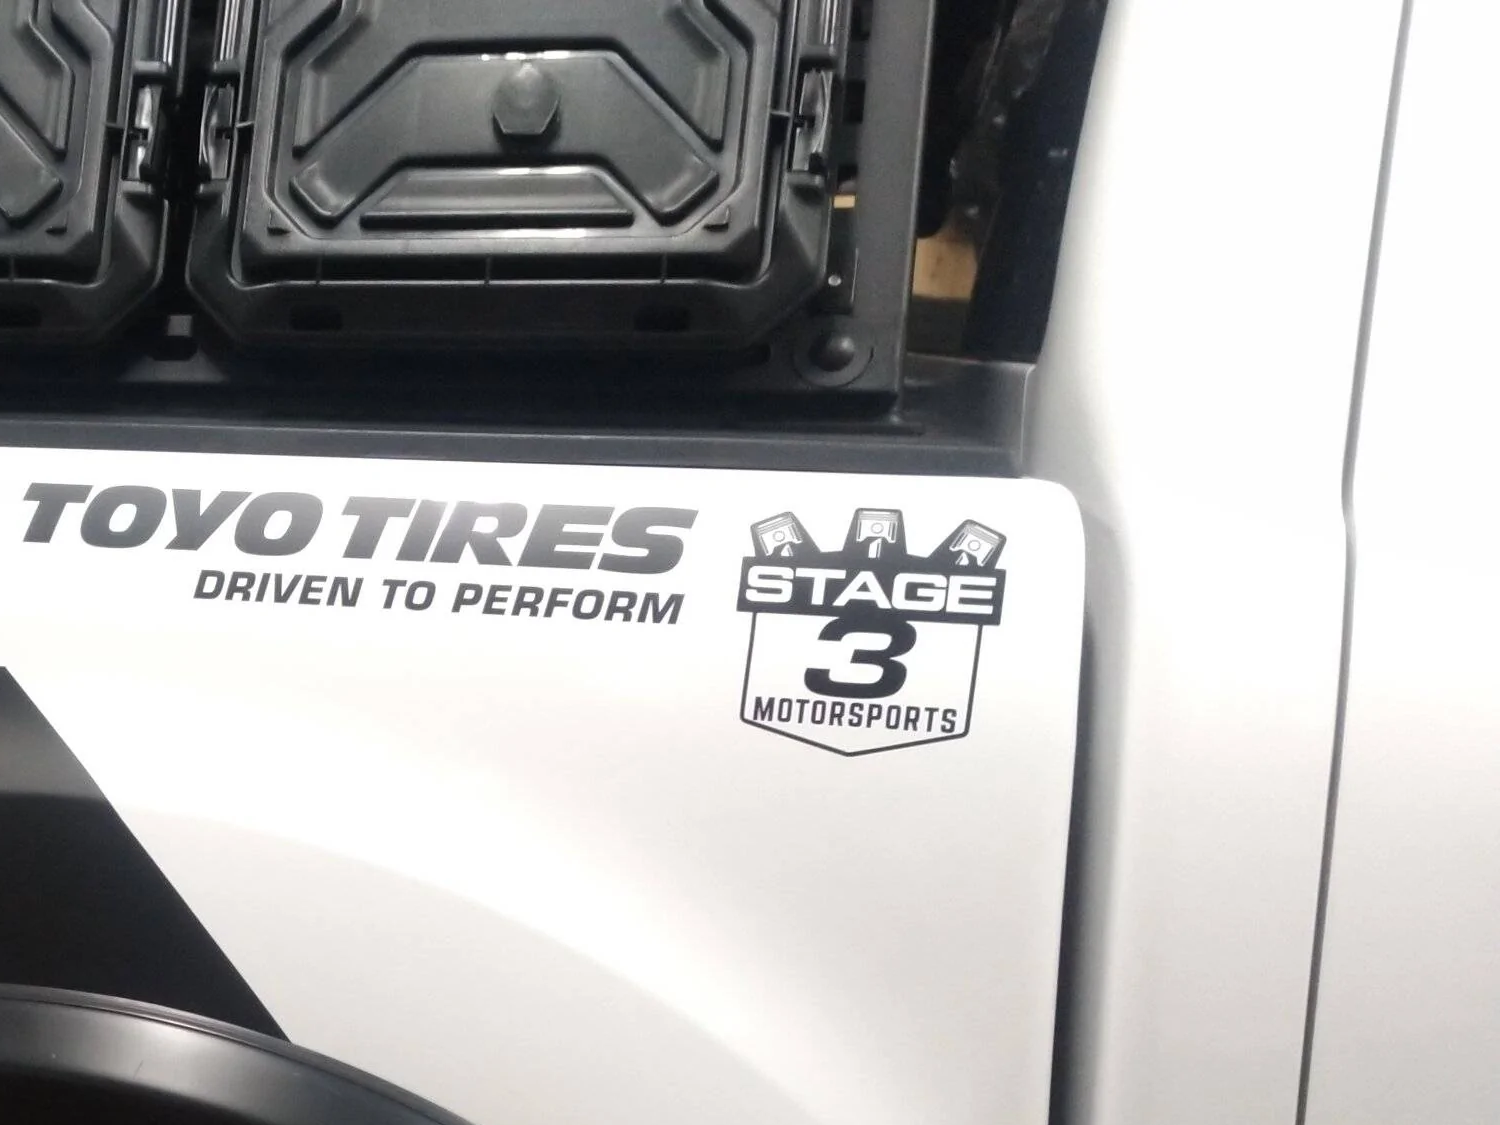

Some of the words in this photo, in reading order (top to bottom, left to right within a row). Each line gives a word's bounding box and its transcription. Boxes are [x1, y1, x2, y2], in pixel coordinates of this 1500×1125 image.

[22, 482, 324, 557] TOYO
[342, 497, 699, 575] TIRES
[192, 569, 365, 608] DRIVEN
[381, 578, 437, 612] TO
[450, 582, 686, 625] PERFORM
[745, 565, 997, 615] STAGE
[804, 616, 917, 700] 3
[753, 696, 959, 734] MOTORSPORTS
